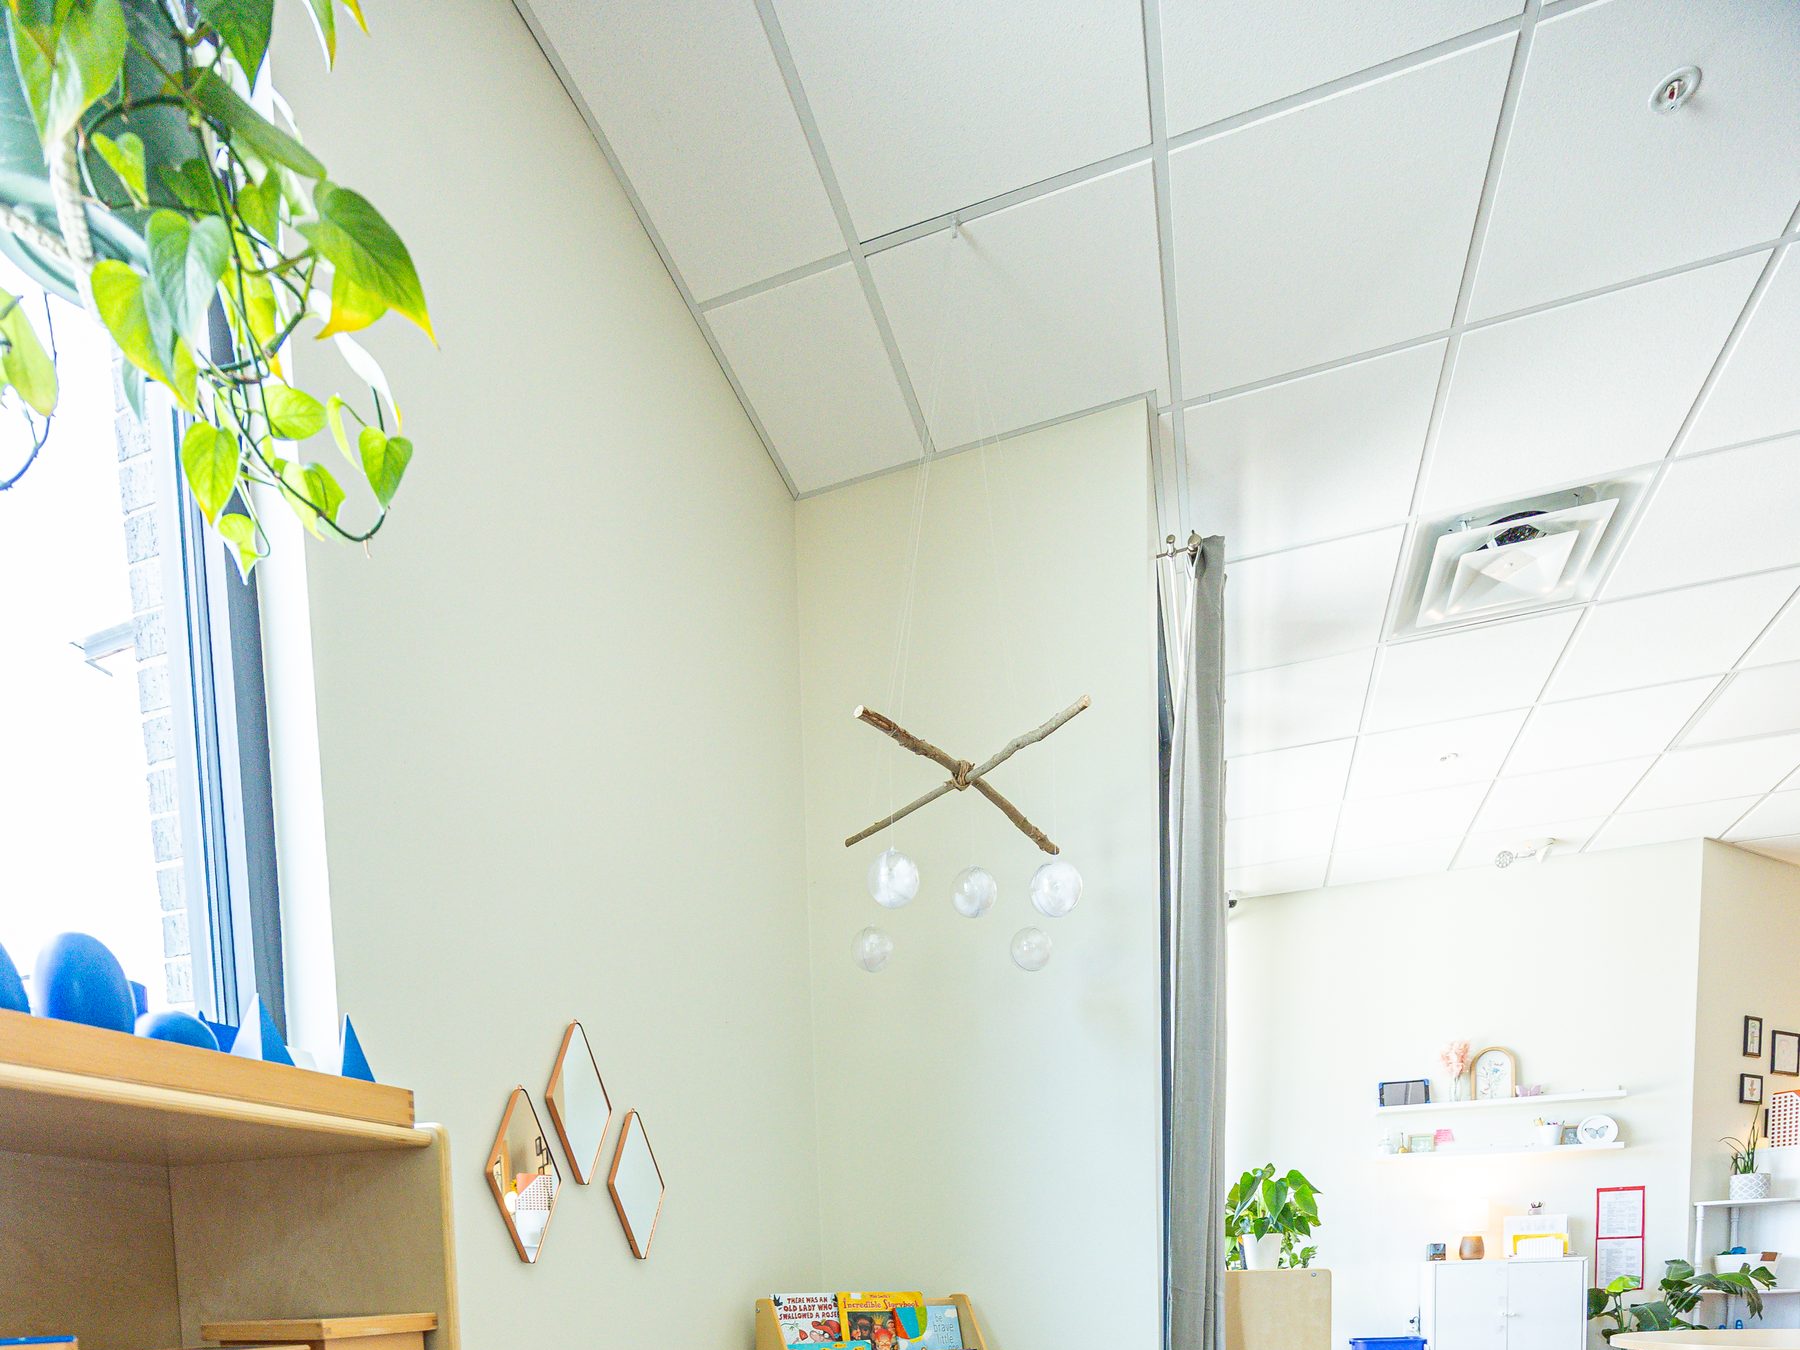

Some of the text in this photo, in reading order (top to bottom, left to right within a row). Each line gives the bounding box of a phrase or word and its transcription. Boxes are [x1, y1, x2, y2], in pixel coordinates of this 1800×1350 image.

[817, 1303, 833, 1311] WHO
[843, 1298, 882, 1309] Incredible
[779, 1312, 814, 1320] SWALLOWED
[933, 1321, 954, 1332] brave
[937, 1333, 954, 1344] little
